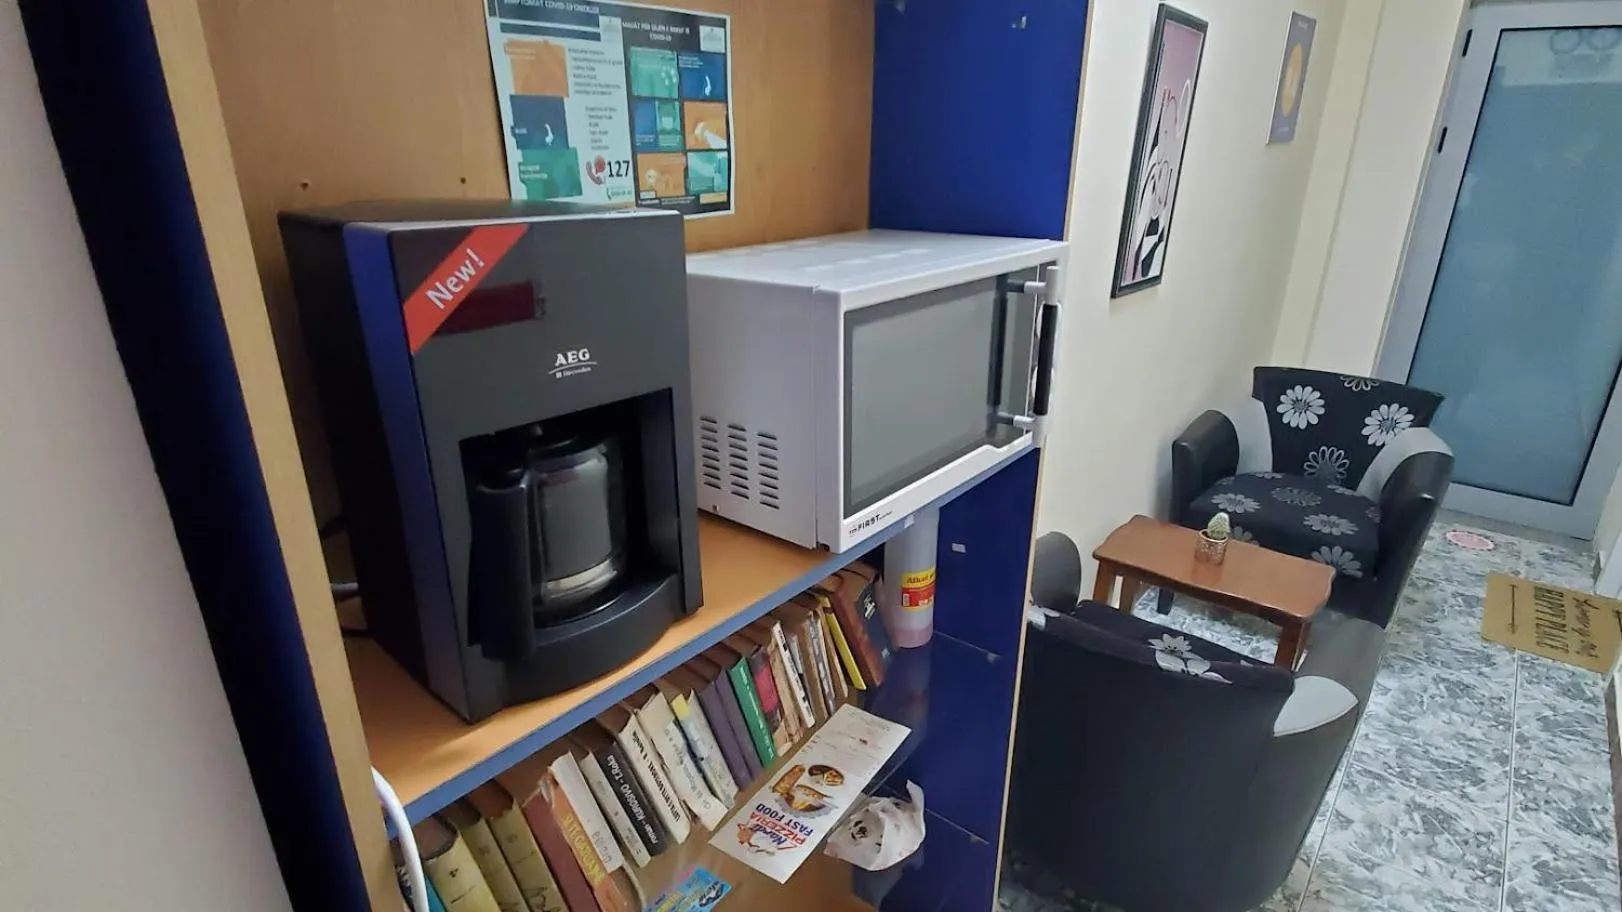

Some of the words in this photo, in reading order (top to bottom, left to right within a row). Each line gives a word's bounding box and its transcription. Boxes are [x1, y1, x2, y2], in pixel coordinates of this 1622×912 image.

[607, 160, 630, 178] 127
[425, 248, 485, 309] New!
[554, 347, 591, 367] AEG
[857, 513, 881, 531] FIRST
[756, 802, 786, 824] FOOD
[749, 811, 807, 846] PIZZERIA
[784, 817, 814, 837] FAST
